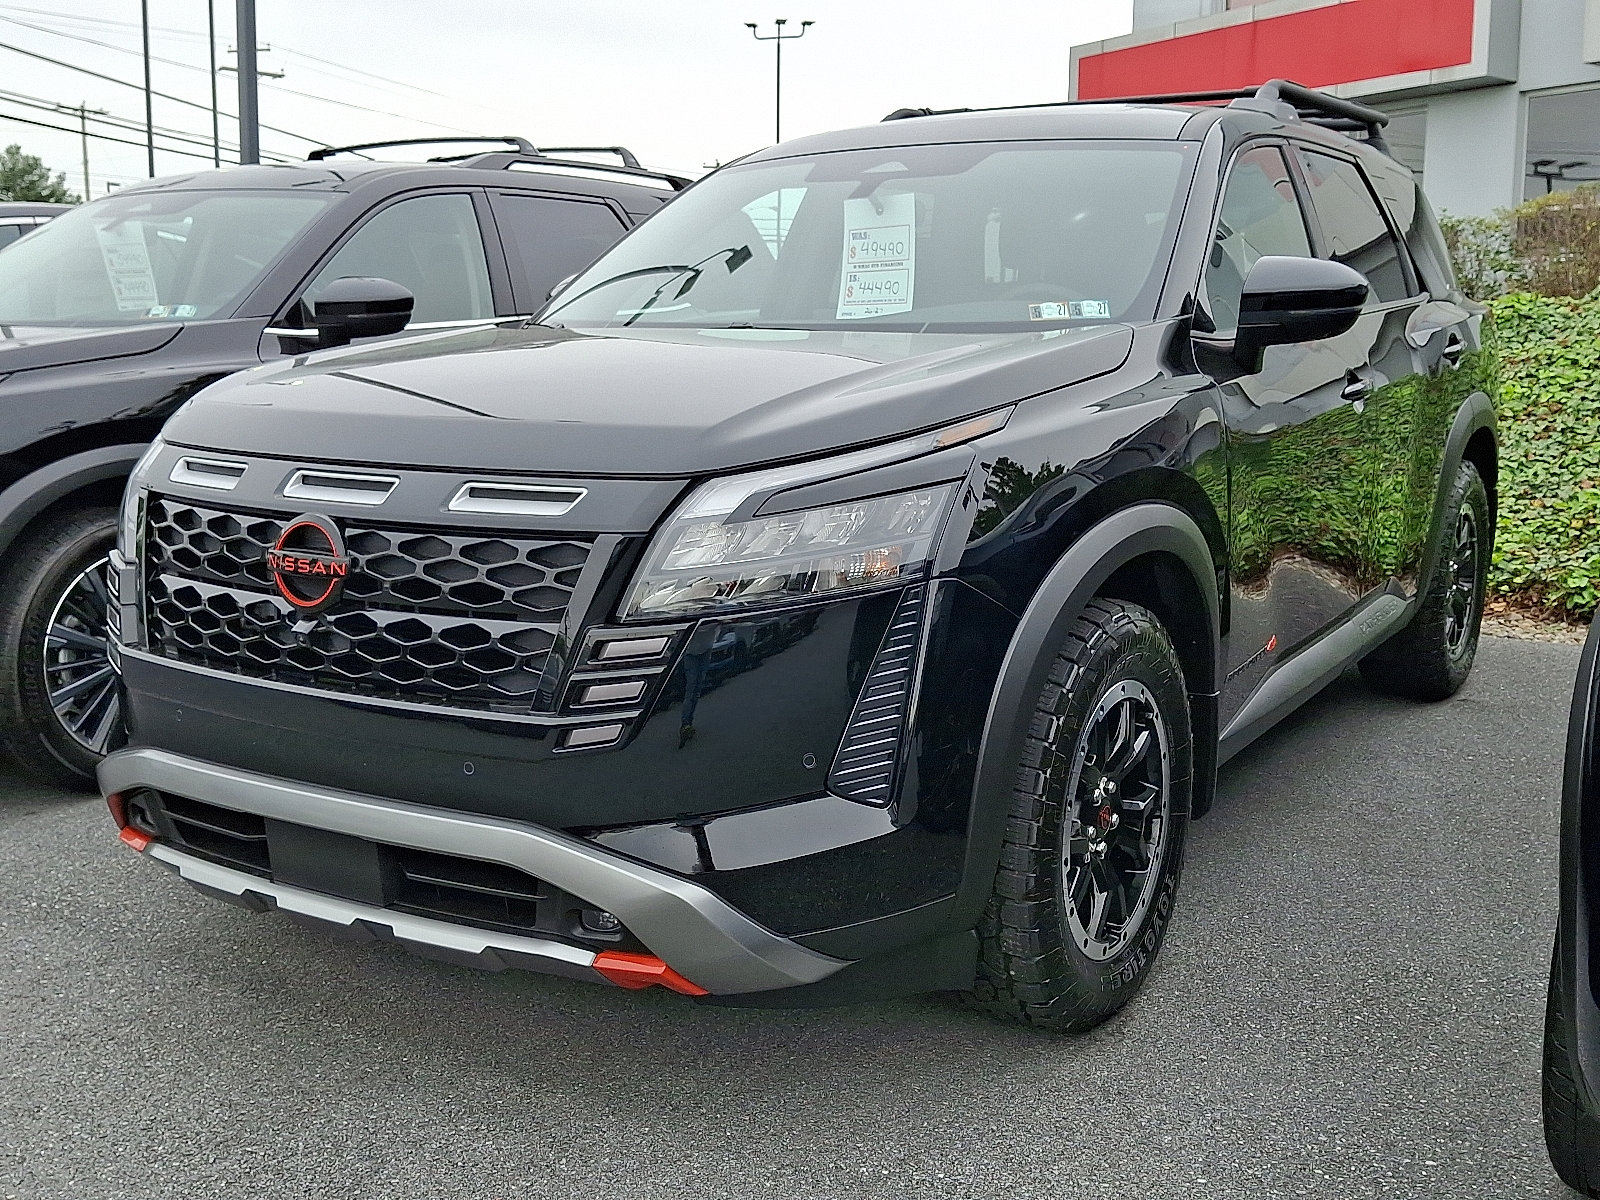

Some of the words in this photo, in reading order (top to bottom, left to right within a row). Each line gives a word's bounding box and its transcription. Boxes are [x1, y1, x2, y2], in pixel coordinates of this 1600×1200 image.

[851, 231, 871, 240] WAS:
[850, 246, 856, 259] $
[861, 241, 904, 256] 49490
[848, 274, 860, 282] IS:
[847, 285, 854, 298] $
[859, 280, 900, 295] 44490
[1057, 303, 1066, 316] 27
[1097, 302, 1106, 315] 27
[268, 553, 347, 576] NISSAN
